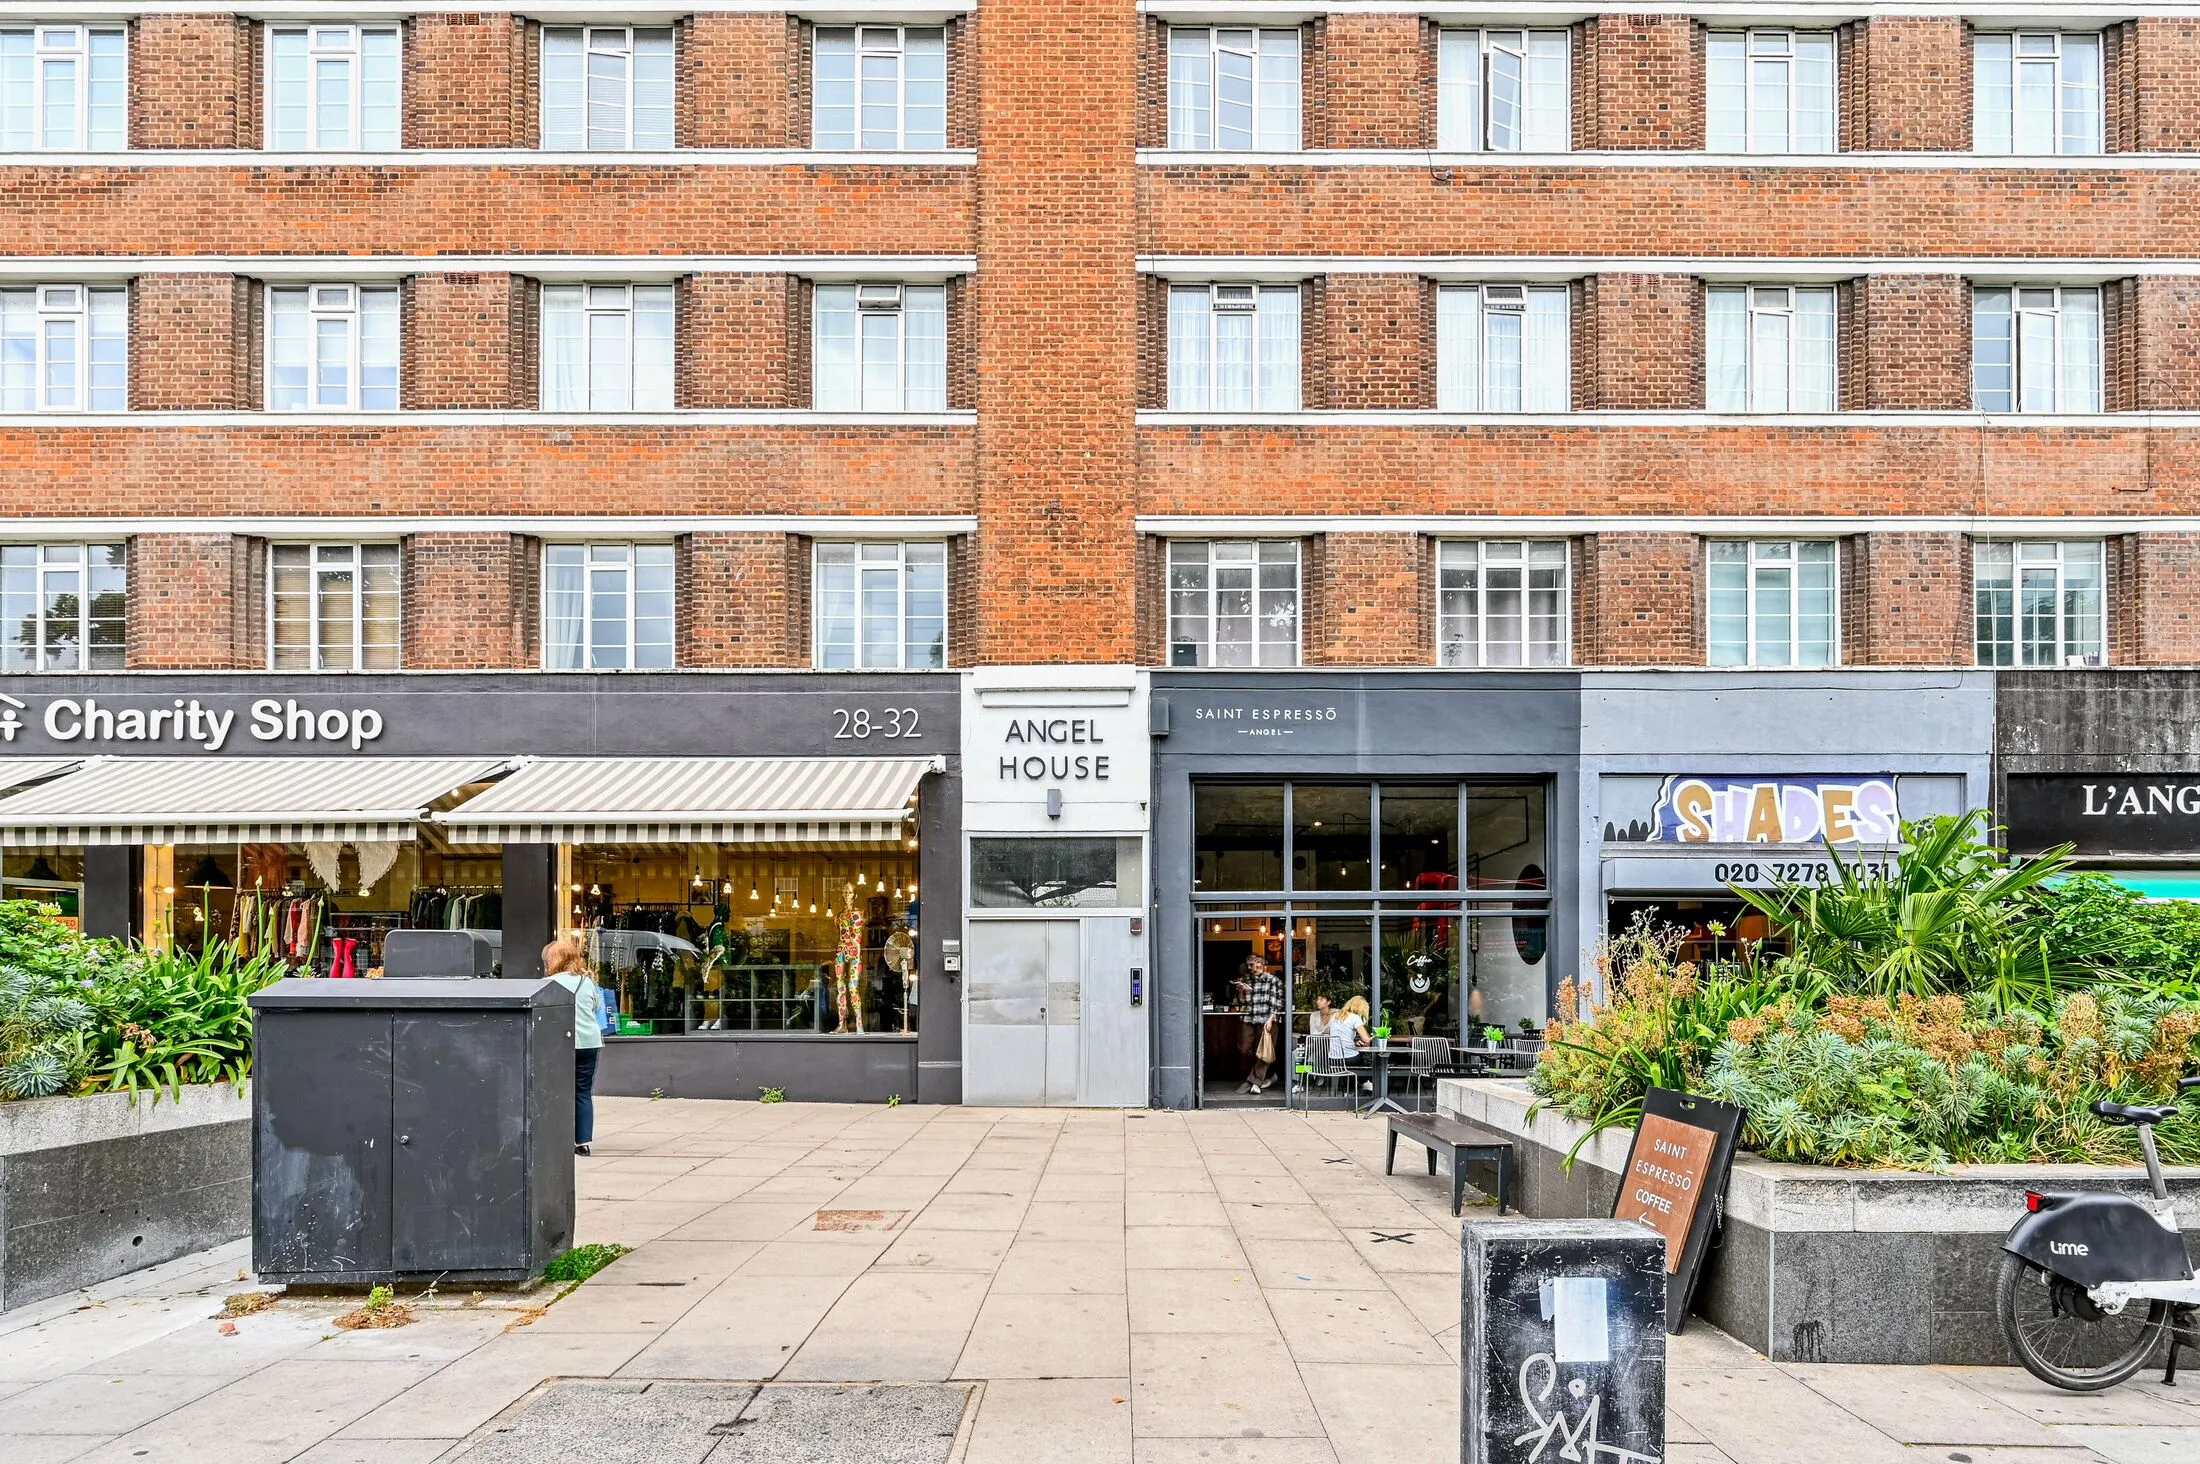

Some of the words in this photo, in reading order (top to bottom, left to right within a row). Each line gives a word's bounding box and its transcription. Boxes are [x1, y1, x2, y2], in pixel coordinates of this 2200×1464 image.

[44, 699, 235, 750] Charity
[250, 699, 383, 750] Shop
[833, 708, 922, 738] 28-32
[1195, 708, 1243, 719] SAINT
[1005, 720, 1103, 743] ANGEL
[1000, 756, 1109, 779] HOUSE
[1673, 779, 1899, 843] SHADES
[1715, 863, 1759, 882] 020
[1772, 863, 1829, 882] 7278
[1654, 1139, 1687, 1159] SAINT
[1636, 1189, 1672, 1214] COFFEE
[2050, 1240, 2089, 1256] Lime
